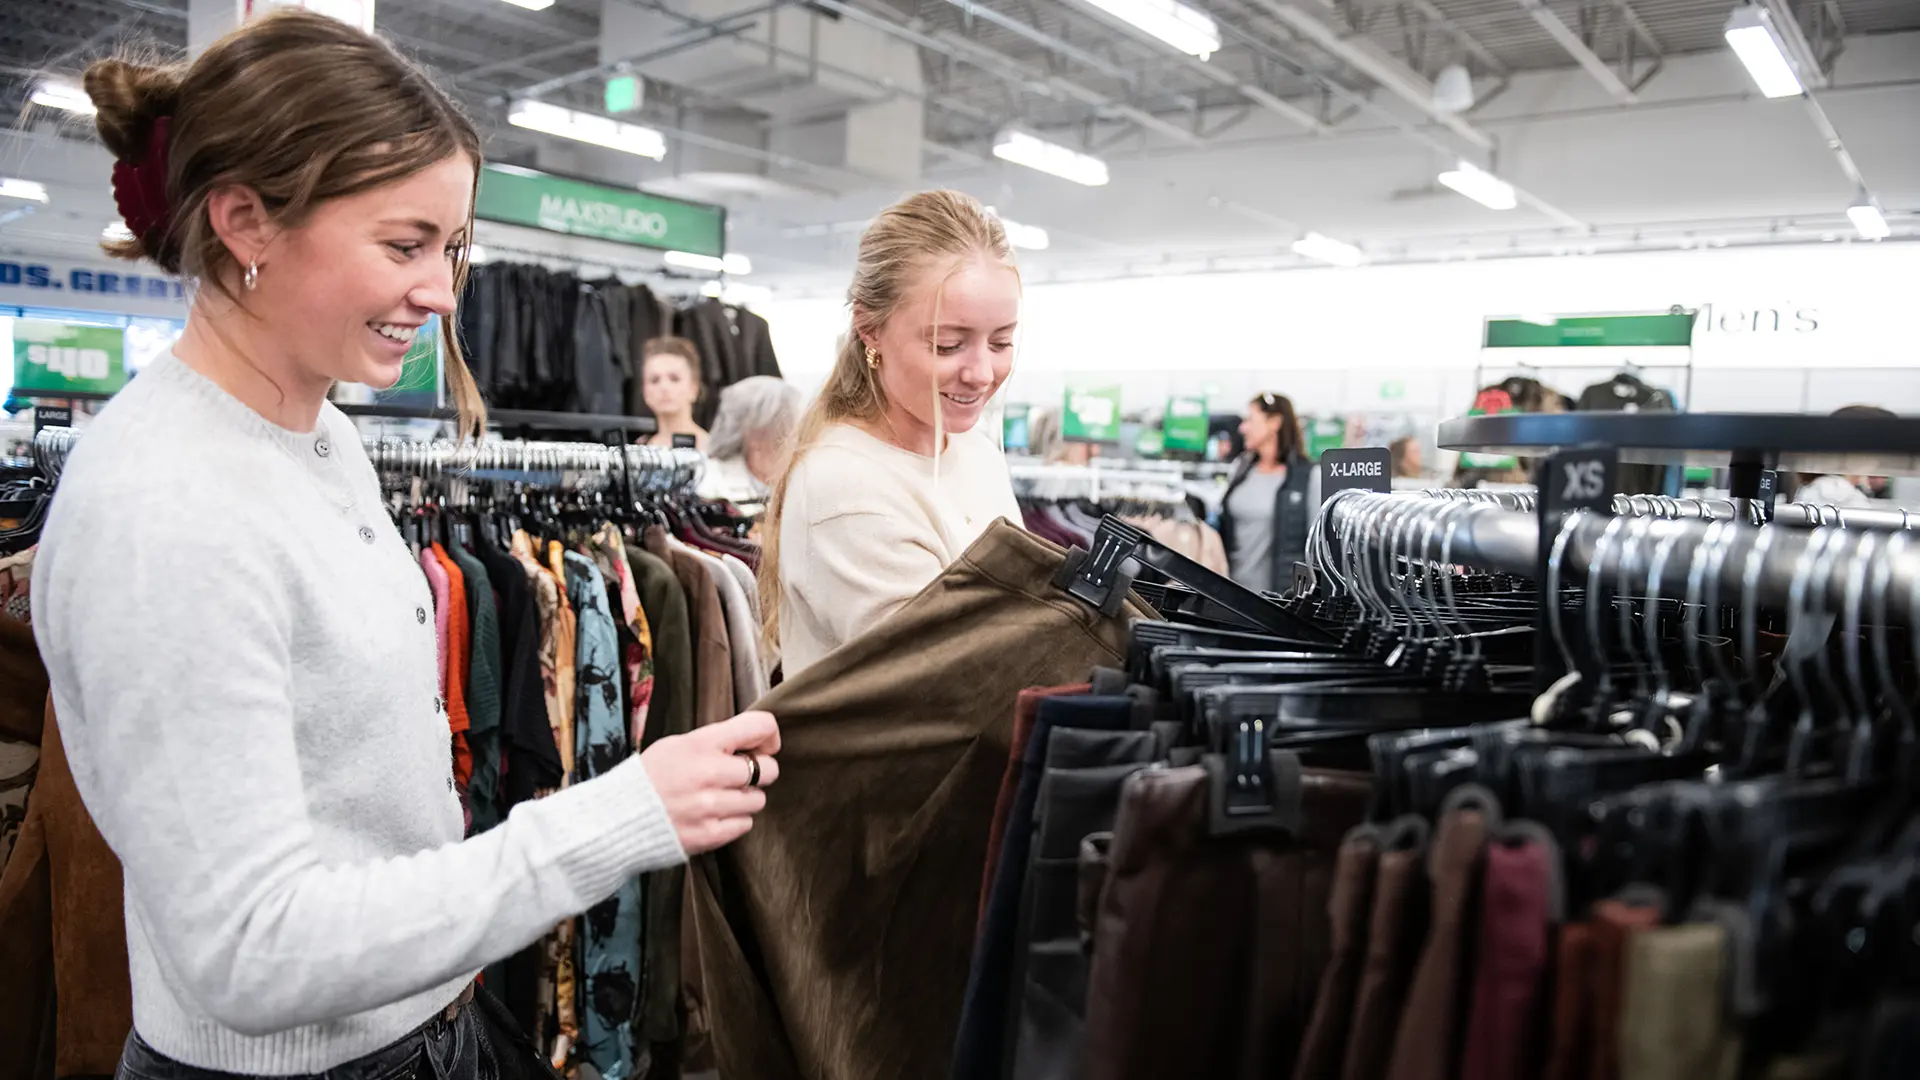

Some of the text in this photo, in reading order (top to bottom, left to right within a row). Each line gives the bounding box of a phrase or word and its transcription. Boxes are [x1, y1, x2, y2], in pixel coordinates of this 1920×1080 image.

[540, 193, 668, 239] MAXSTUDIO
[38, 410, 69, 421] LARGE
[1330, 461, 1382, 477] X-LARGE
[1561, 460, 1606, 500] XS
